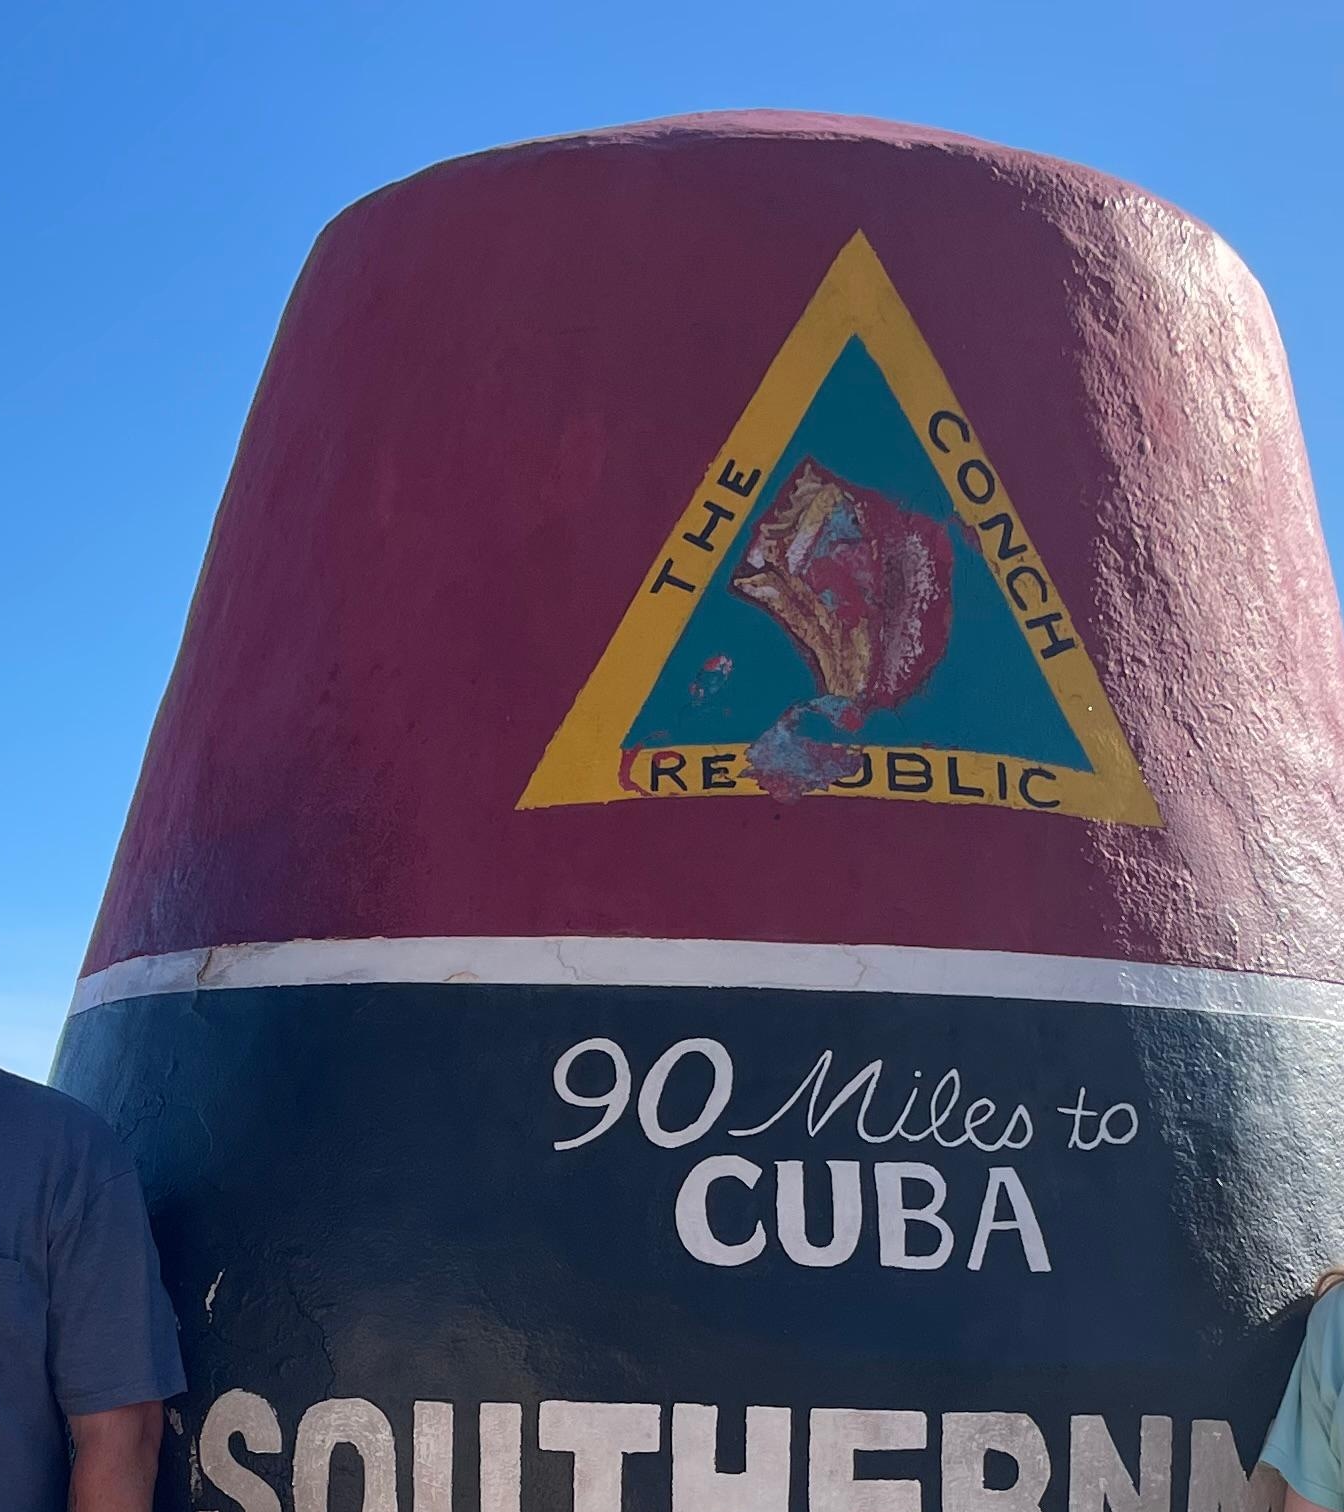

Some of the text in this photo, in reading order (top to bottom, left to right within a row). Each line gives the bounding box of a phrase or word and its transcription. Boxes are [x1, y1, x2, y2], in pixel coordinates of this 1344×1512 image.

[649, 458, 762, 598] THE
[927, 408, 1076, 661] CONCH
[649, 751, 1061, 809] REUBLIC
[552, 1037, 1139, 1152] 90 Miles to
[673, 1154, 1052, 1273] CUBA
